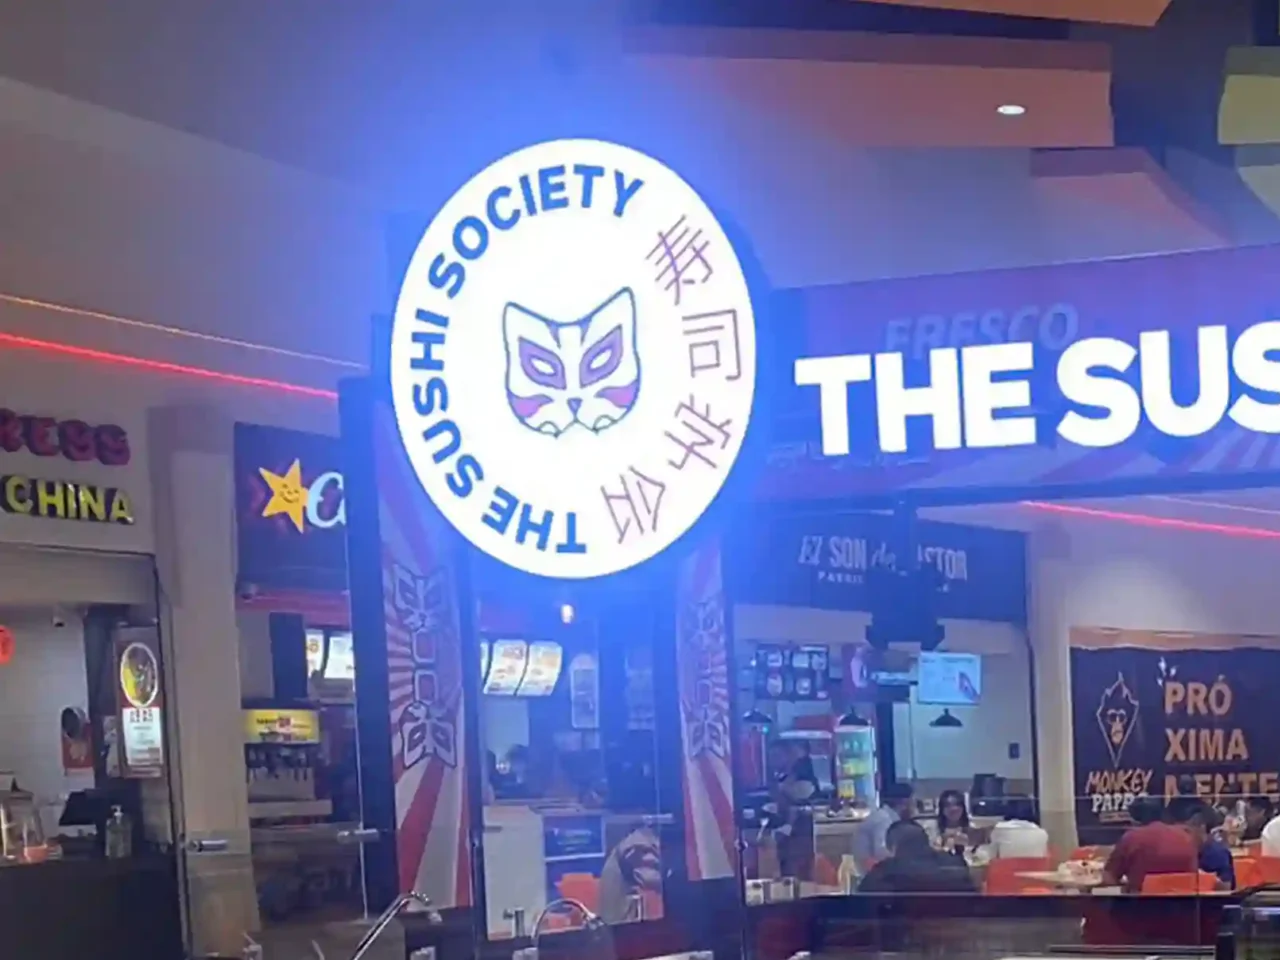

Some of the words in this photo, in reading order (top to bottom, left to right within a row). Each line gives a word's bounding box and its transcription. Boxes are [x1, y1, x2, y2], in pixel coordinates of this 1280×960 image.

[429, 164, 644, 298] SOCIETY
[410, 308, 484, 499] SUSHI
[794, 341, 1037, 457] THE
[3, 475, 134, 525] CHINA
[481, 486, 587, 554] THE
[1164, 674, 1232, 716] PRÓ
[1164, 727, 1249, 762] XIMA
[1085, 768, 1153, 795] MONKEY
[1091, 792, 1149, 813] PAPP
